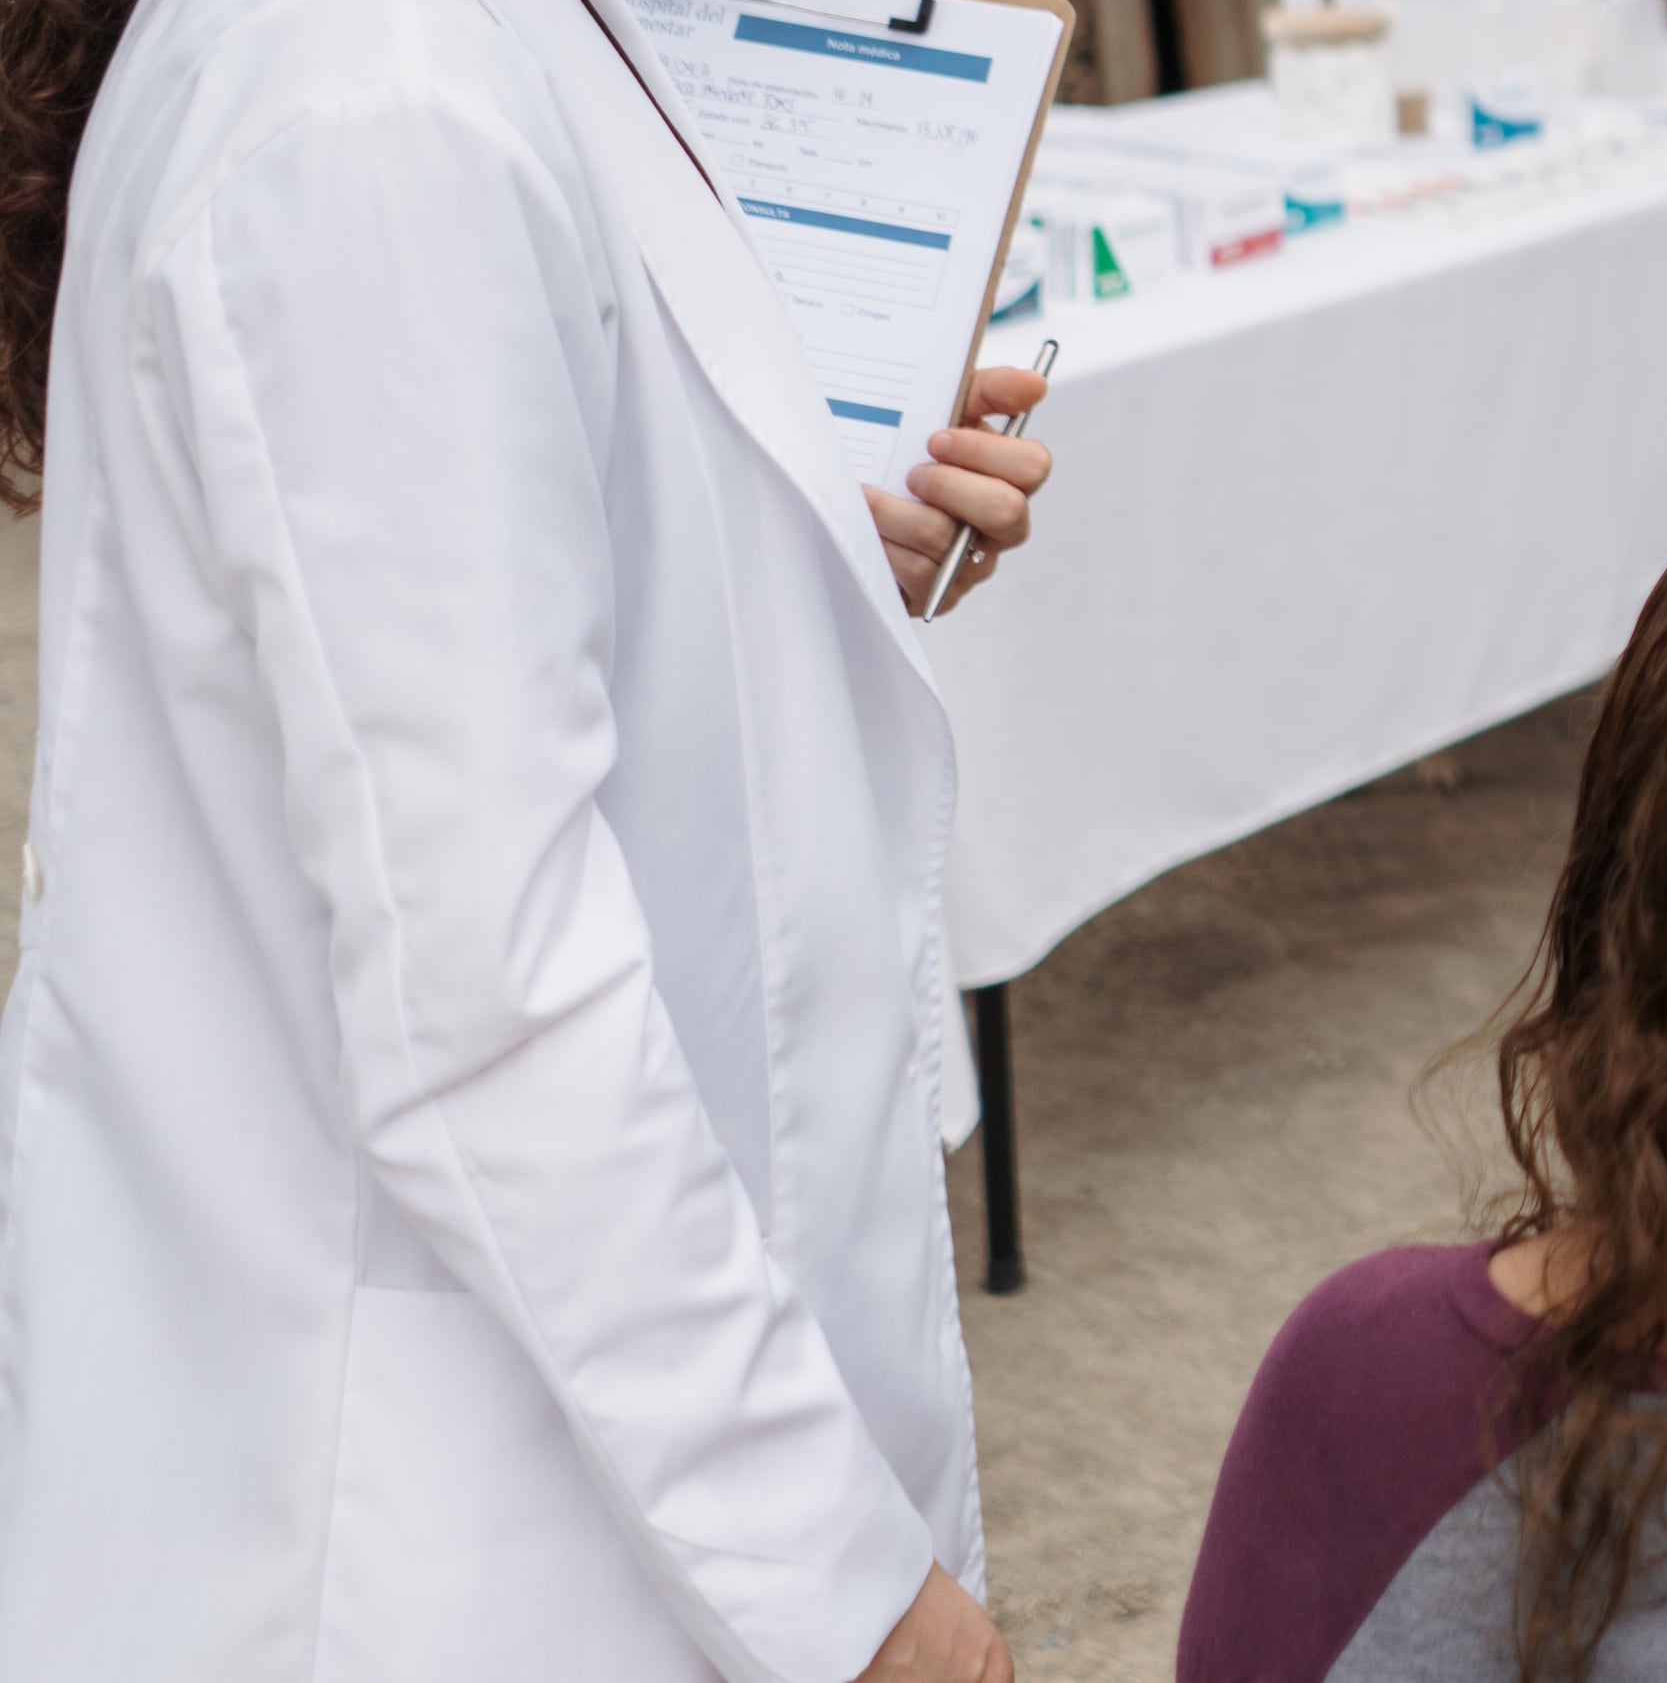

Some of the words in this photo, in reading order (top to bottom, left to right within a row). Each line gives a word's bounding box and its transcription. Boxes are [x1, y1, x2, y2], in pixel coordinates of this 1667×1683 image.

[695, 1, 726, 24] del
[640, 17, 695, 39] nestar
[826, 37, 856, 54] Nota
[858, 41, 902, 61] médica
